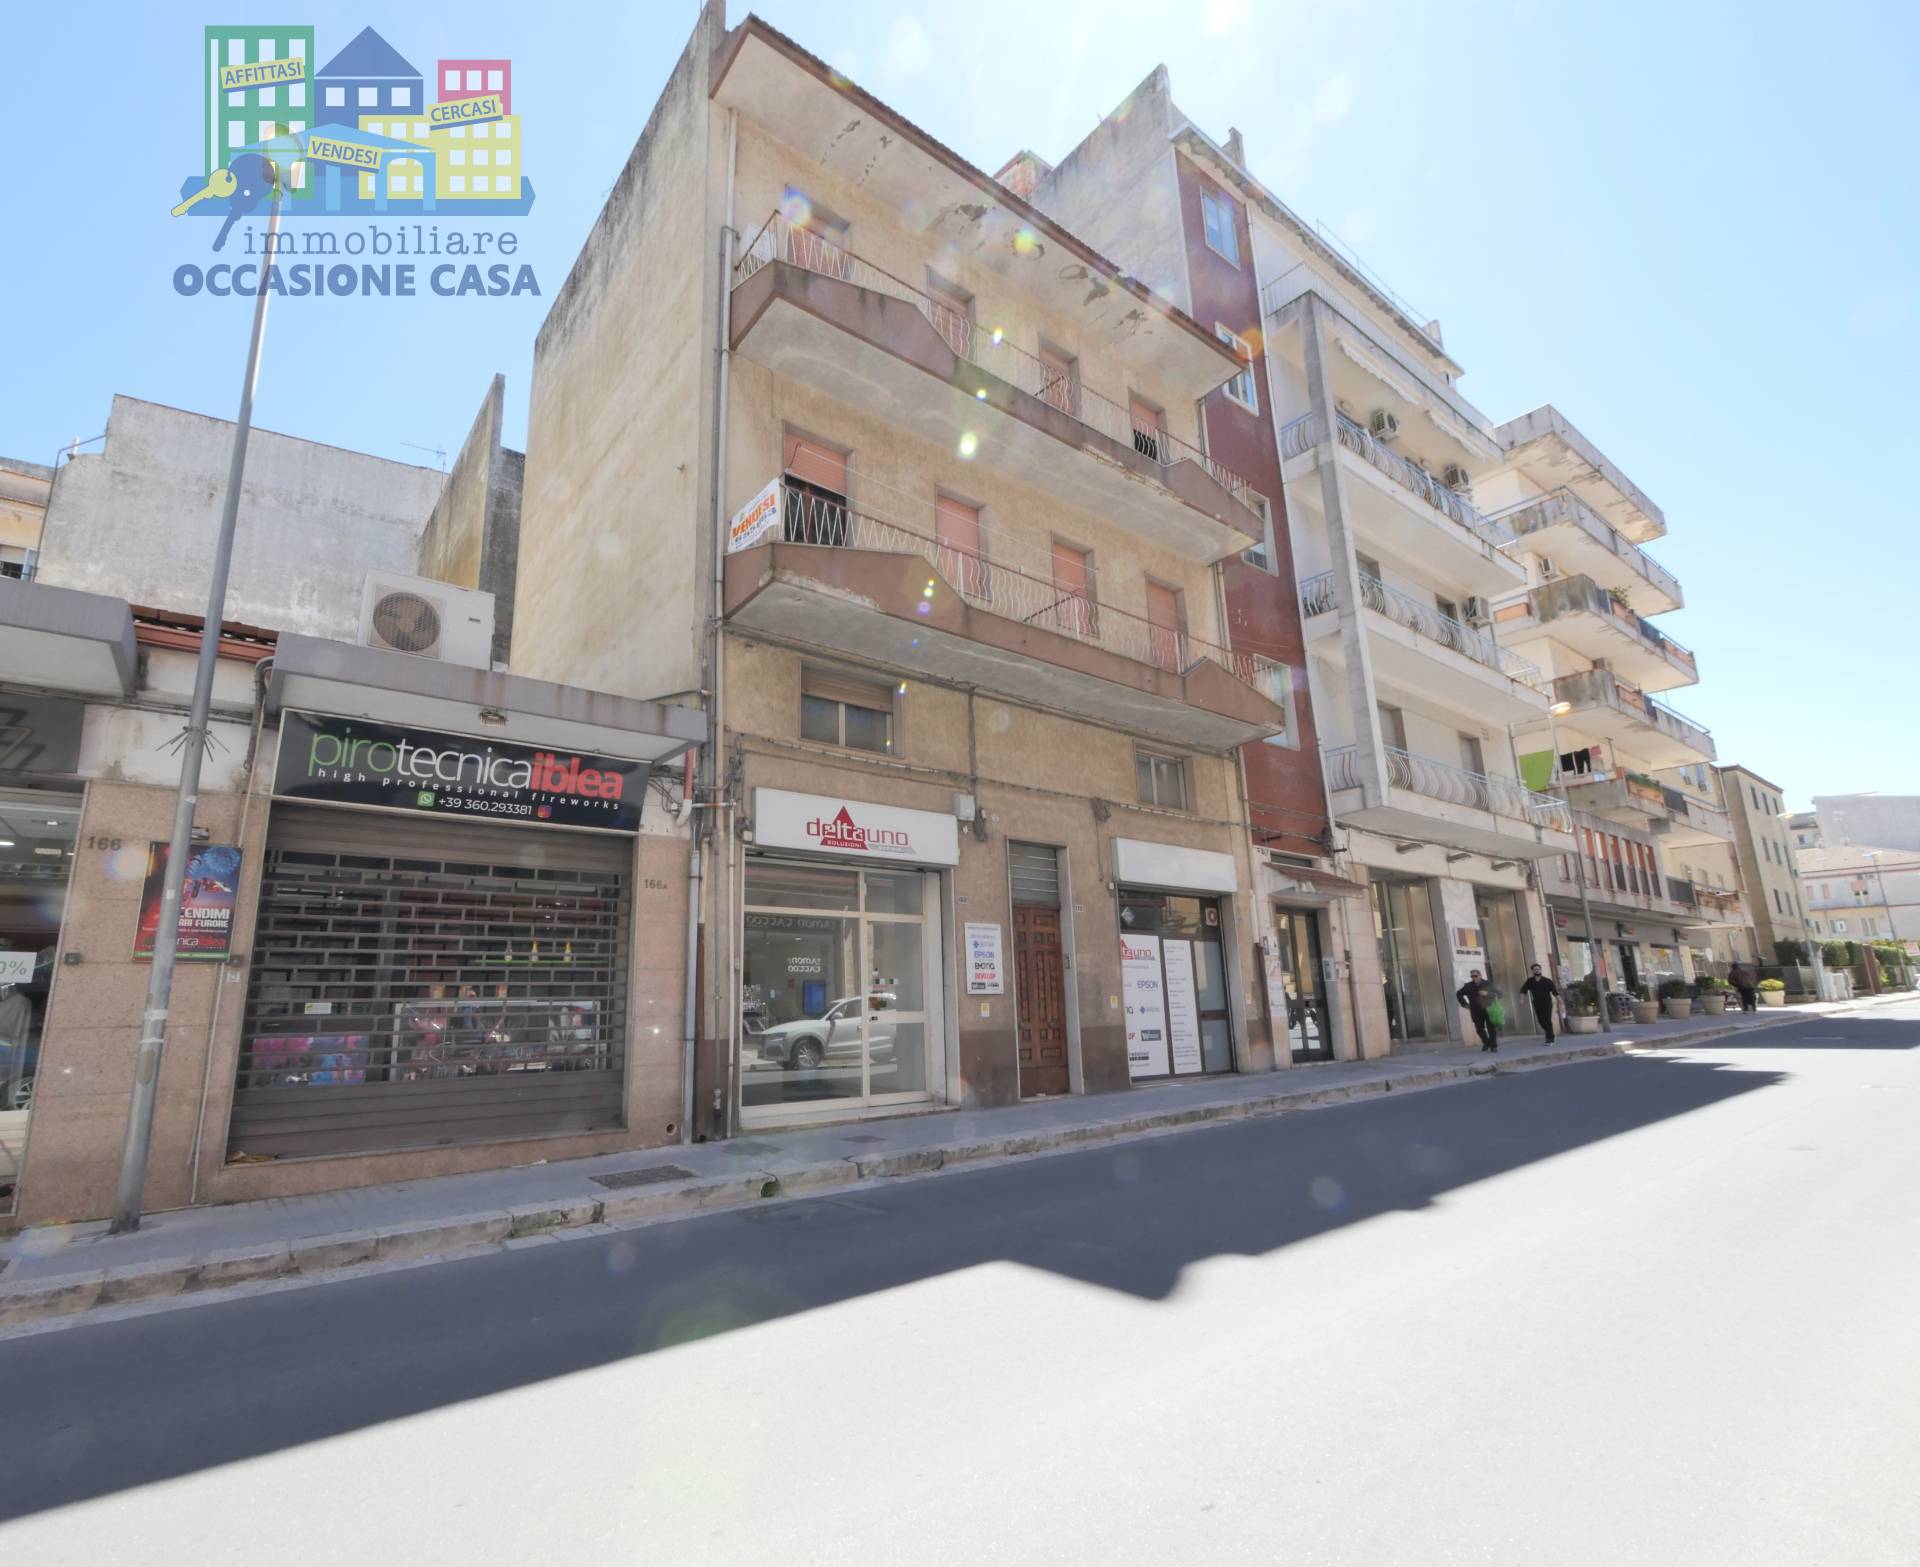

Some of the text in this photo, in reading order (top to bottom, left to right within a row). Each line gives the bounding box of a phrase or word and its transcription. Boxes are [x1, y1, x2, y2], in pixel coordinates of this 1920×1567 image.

[732, 494, 775, 538] VENDESI
[318, 768, 619, 810] high professional fireworks
[439, 797, 532, 815] +39 360.293381
[87, 836, 122, 851] 166
[1136, 980, 1159, 989] EPSON
